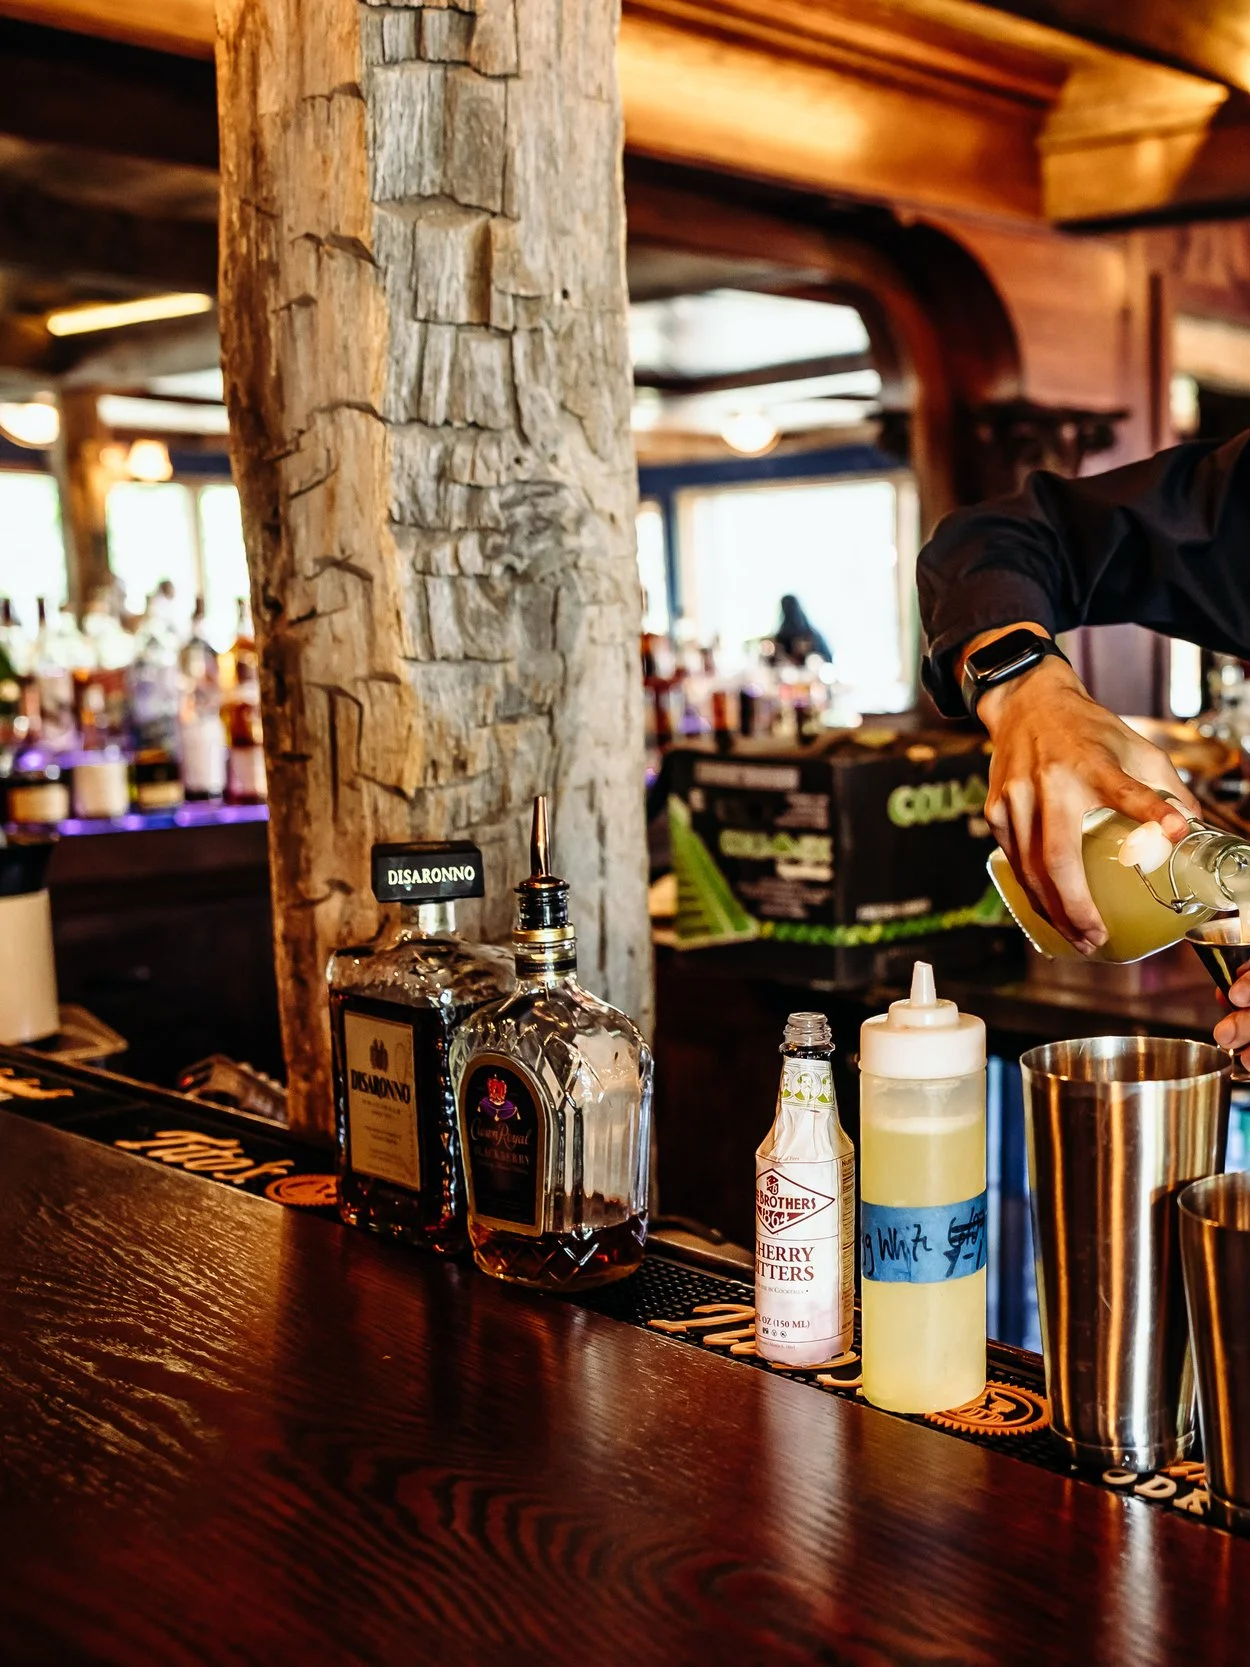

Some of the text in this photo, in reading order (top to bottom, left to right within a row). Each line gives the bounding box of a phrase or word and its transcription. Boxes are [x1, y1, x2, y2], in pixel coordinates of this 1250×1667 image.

[388, 865, 476, 885] DISARONNO
[350, 1069, 411, 1105] DISARONNO
[470, 1118, 532, 1150] Crown Royal
[760, 1189, 817, 1210] BROTHERS
[756, 1242, 815, 1263] HERRY
[756, 1258, 815, 1281] ITTERS
[762, 1316, 771, 1326] OZ
[773, 1319, 790, 1328] (150
[792, 1320, 810, 1329] ML)
